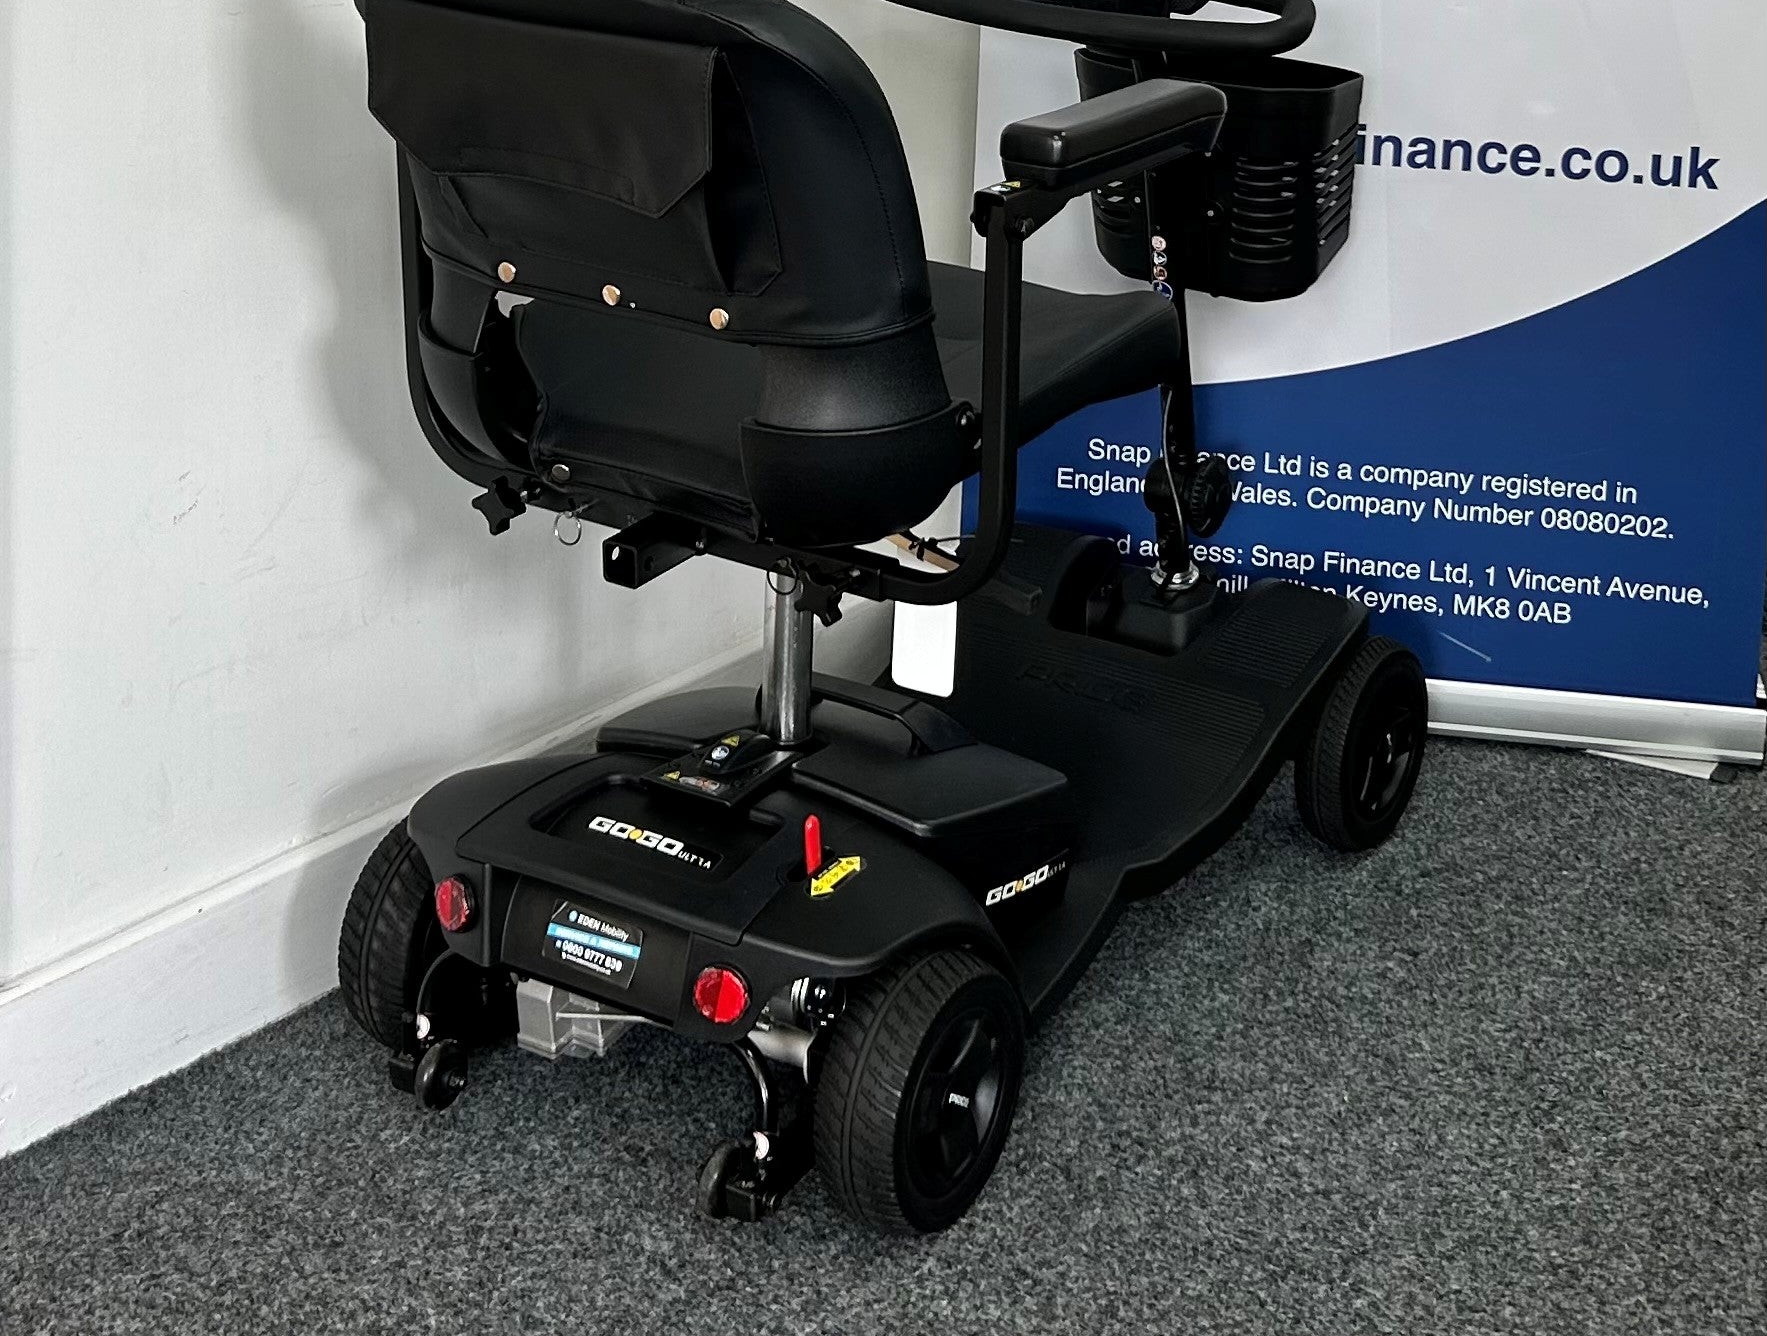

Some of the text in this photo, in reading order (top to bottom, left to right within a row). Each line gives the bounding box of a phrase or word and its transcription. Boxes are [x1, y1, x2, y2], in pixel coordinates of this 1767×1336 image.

[1356, 123, 1720, 190] inance.co.uk
[1088, 438, 1151, 468] Snap
[1264, 451, 1302, 476] Ltd
[1309, 455, 1330, 479] is
[1337, 463, 1353, 481] a
[1359, 464, 1475, 495] company
[1481, 472, 1608, 502] registered
[1615, 481, 1637, 504] in
[1306, 486, 1427, 523] Company
[1433, 497, 1534, 527] Number
[1540, 507, 1674, 539] 08080202.
[1251, 544, 1315, 575] Snap
[1323, 551, 1421, 580] Finance
[1429, 559, 1474, 588] Ltd,
[1485, 565, 1495, 587] 1
[1507, 566, 1601, 596] Vincent
[1605, 576, 1709, 609] Avenue,
[1346, 584, 1444, 617] Keynes,
[1453, 593, 1511, 620] MK8
[1518, 600, 1572, 624] 0AB
